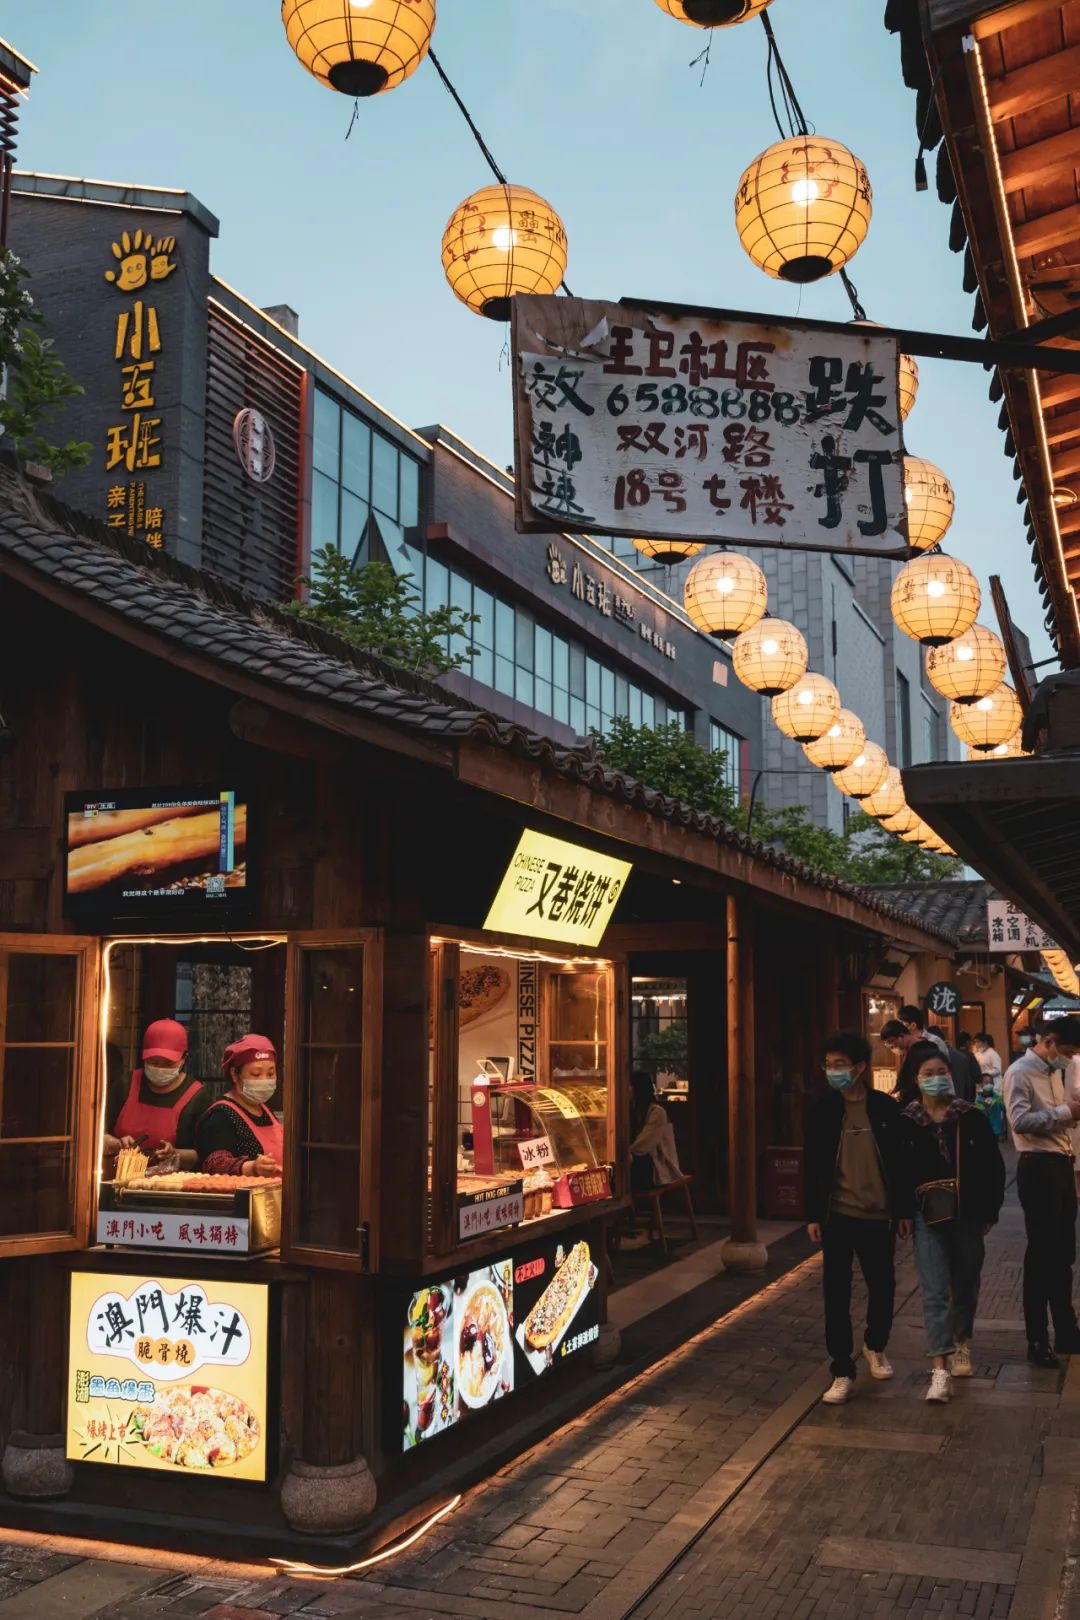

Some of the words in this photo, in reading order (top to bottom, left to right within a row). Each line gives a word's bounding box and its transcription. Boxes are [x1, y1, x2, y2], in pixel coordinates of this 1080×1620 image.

[106, 301, 161, 471] 小五班
[616, 421, 775, 468] 双河路
[804, 355, 897, 537] 跌打
[613, 467, 794, 528] 18号七楼
[145, 507, 163, 549] 陪伴
[514, 852, 546, 874] CHINESE
[514, 875, 536, 893] PIZZA
[525, 862, 612, 929] 又卷烧饼
[1006, 916, 1021, 941] 空调
[522, 1142, 549, 1161] 冰粉
[106, 1220, 165, 1241] 澳門小吃
[178, 1224, 239, 1246] 風味獨特
[97, 1289, 242, 1355] 澳門爆汁
[138, 1341, 191, 1364] 脆骨燒
